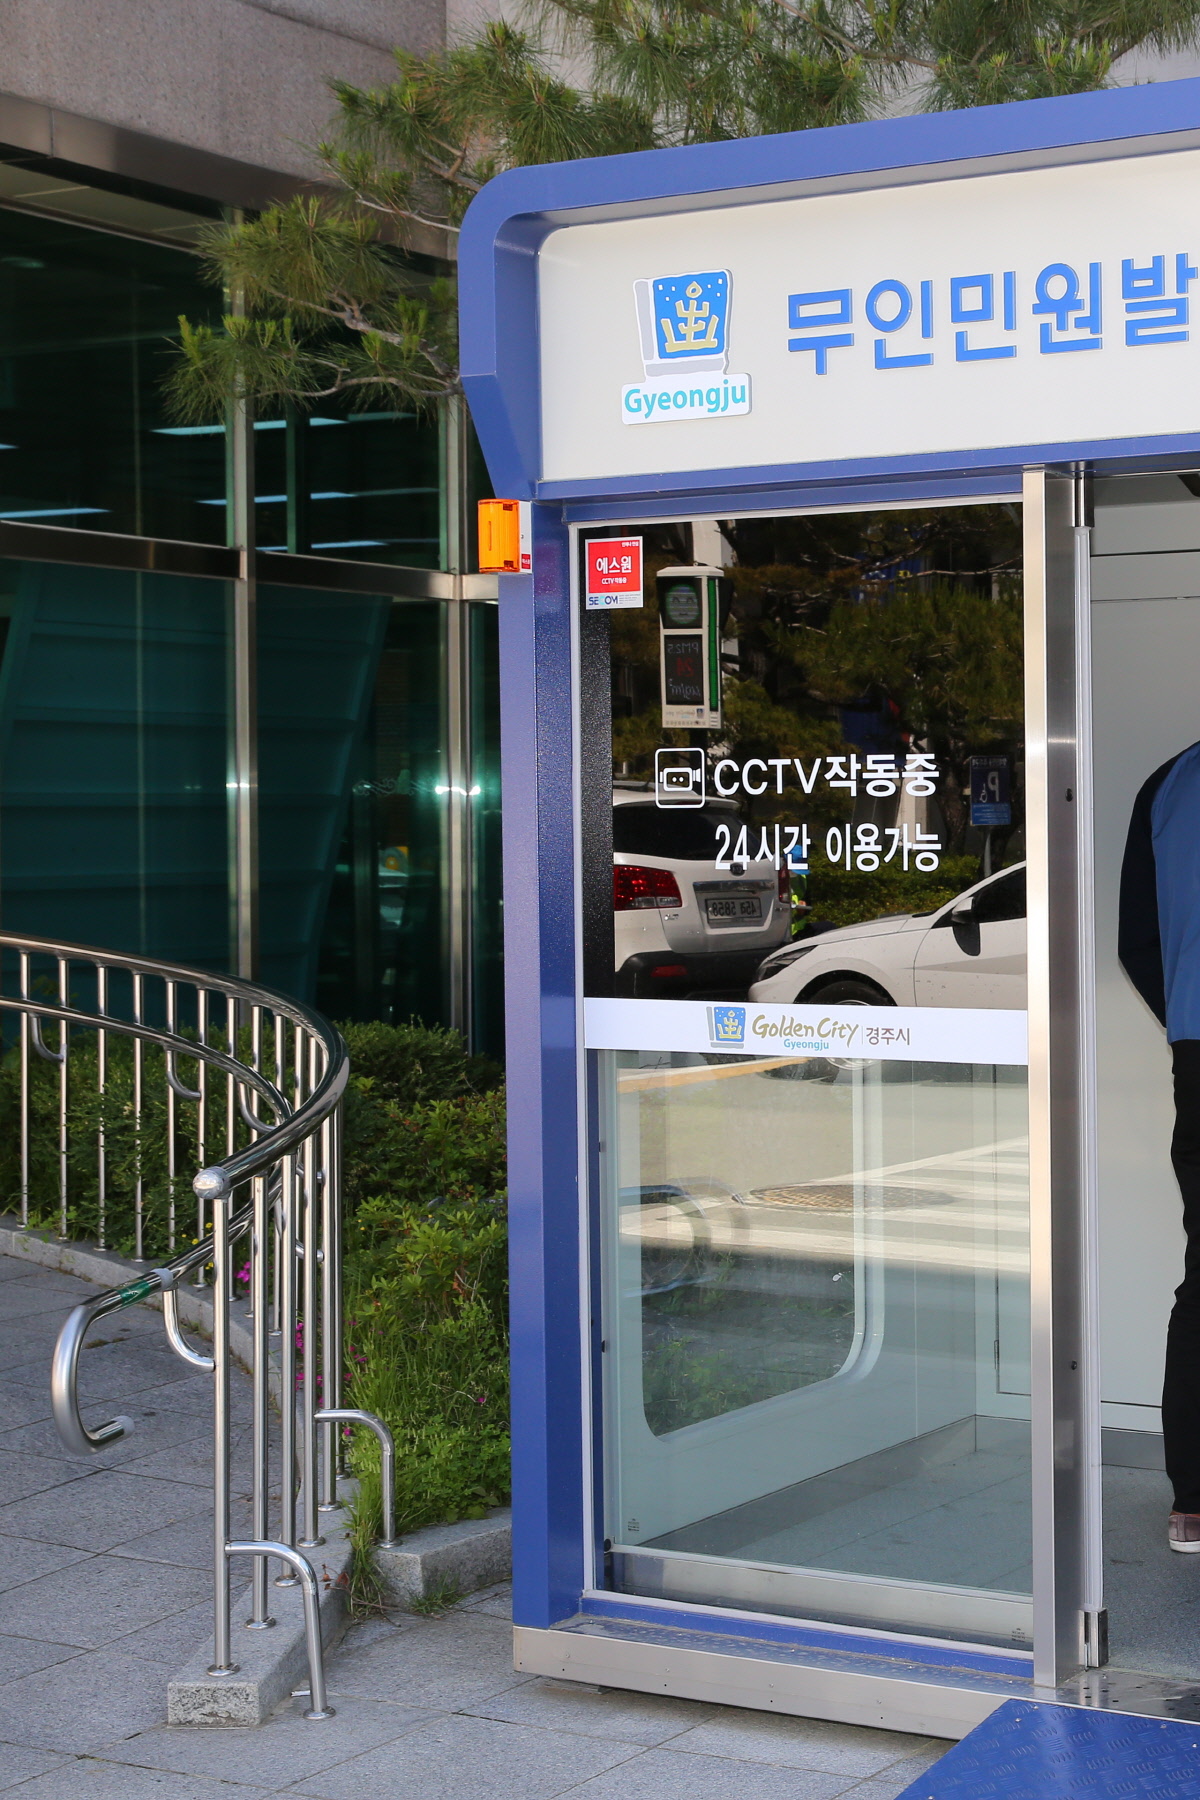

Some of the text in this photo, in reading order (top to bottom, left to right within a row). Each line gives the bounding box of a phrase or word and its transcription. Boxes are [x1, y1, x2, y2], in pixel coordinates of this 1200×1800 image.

[624, 378, 747, 418] Gyeongju
[595, 555, 632, 575] 에스원
[588, 595, 619, 606] SECOM
[713, 752, 940, 798] CCTV작동중
[714, 822, 943, 873] 24시간 이용가능
[751, 1013, 860, 1048] Golden City
[865, 1026, 911, 1046] 경주시
[783, 1039, 830, 1051] Gyeongju
